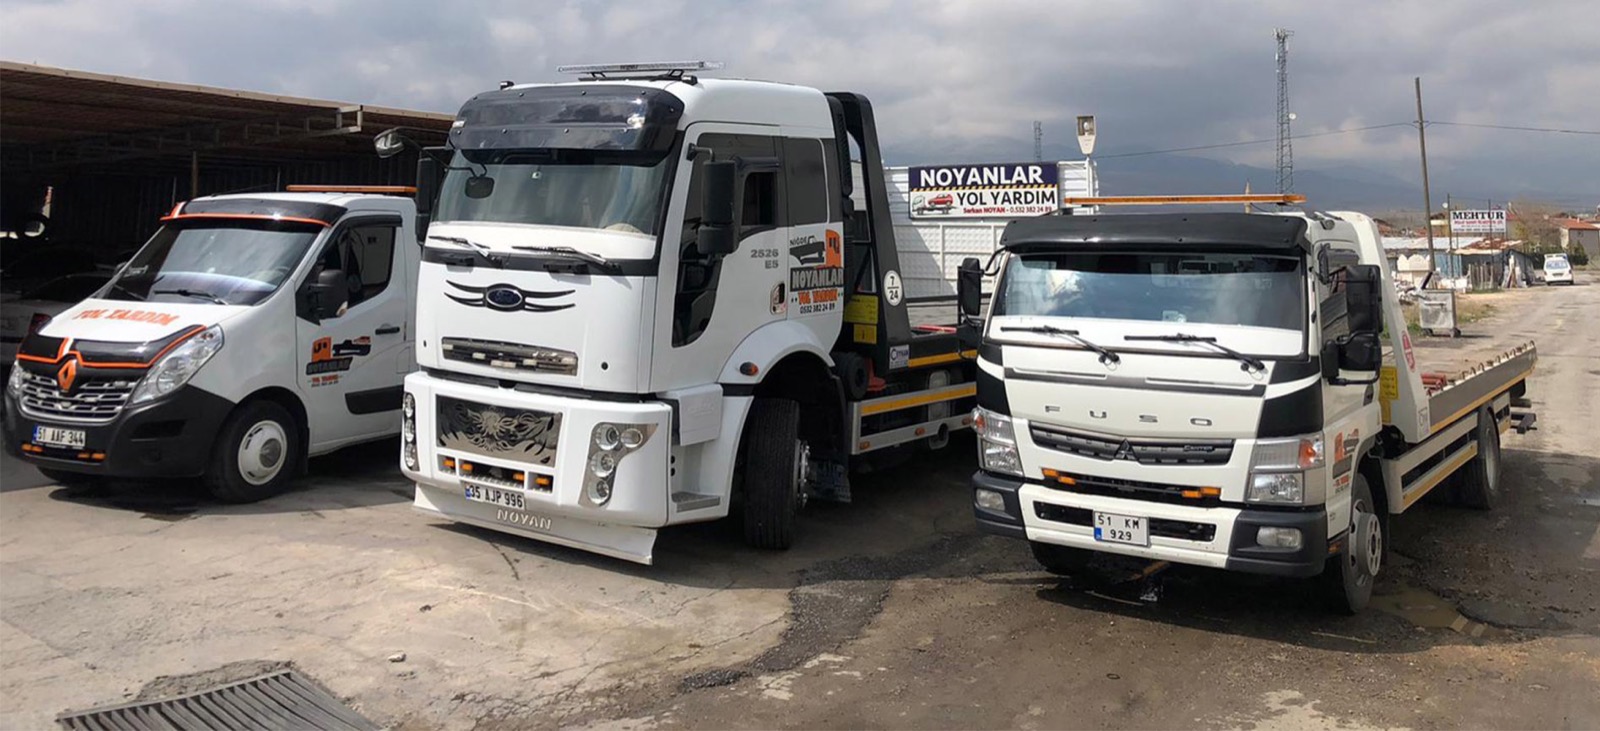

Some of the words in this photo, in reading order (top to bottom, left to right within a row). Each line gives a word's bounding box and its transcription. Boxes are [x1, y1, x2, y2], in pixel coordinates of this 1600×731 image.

[920, 166, 1044, 187] NOYANLAR
[957, 192, 987, 206] YOL
[991, 190, 1056, 205] YARDIM
[1452, 211, 1504, 220] MEHTUR
[750, 249, 779, 258] 2526
[765, 260, 779, 269] E5
[890, 276, 895, 286] 7
[889, 290, 899, 300] 24
[1045, 405, 1212, 425] FUSO
[38, 427, 46, 440] 51
[69, 431, 83, 444] 344
[470, 485, 481, 499] 35
[485, 488, 502, 503] AJP
[504, 492, 523, 508] 996
[497, 509, 551, 529] NOYAN
[1098, 514, 1111, 526] 51
[1125, 518, 1139, 529] KM
[1110, 529, 1132, 540] 929
